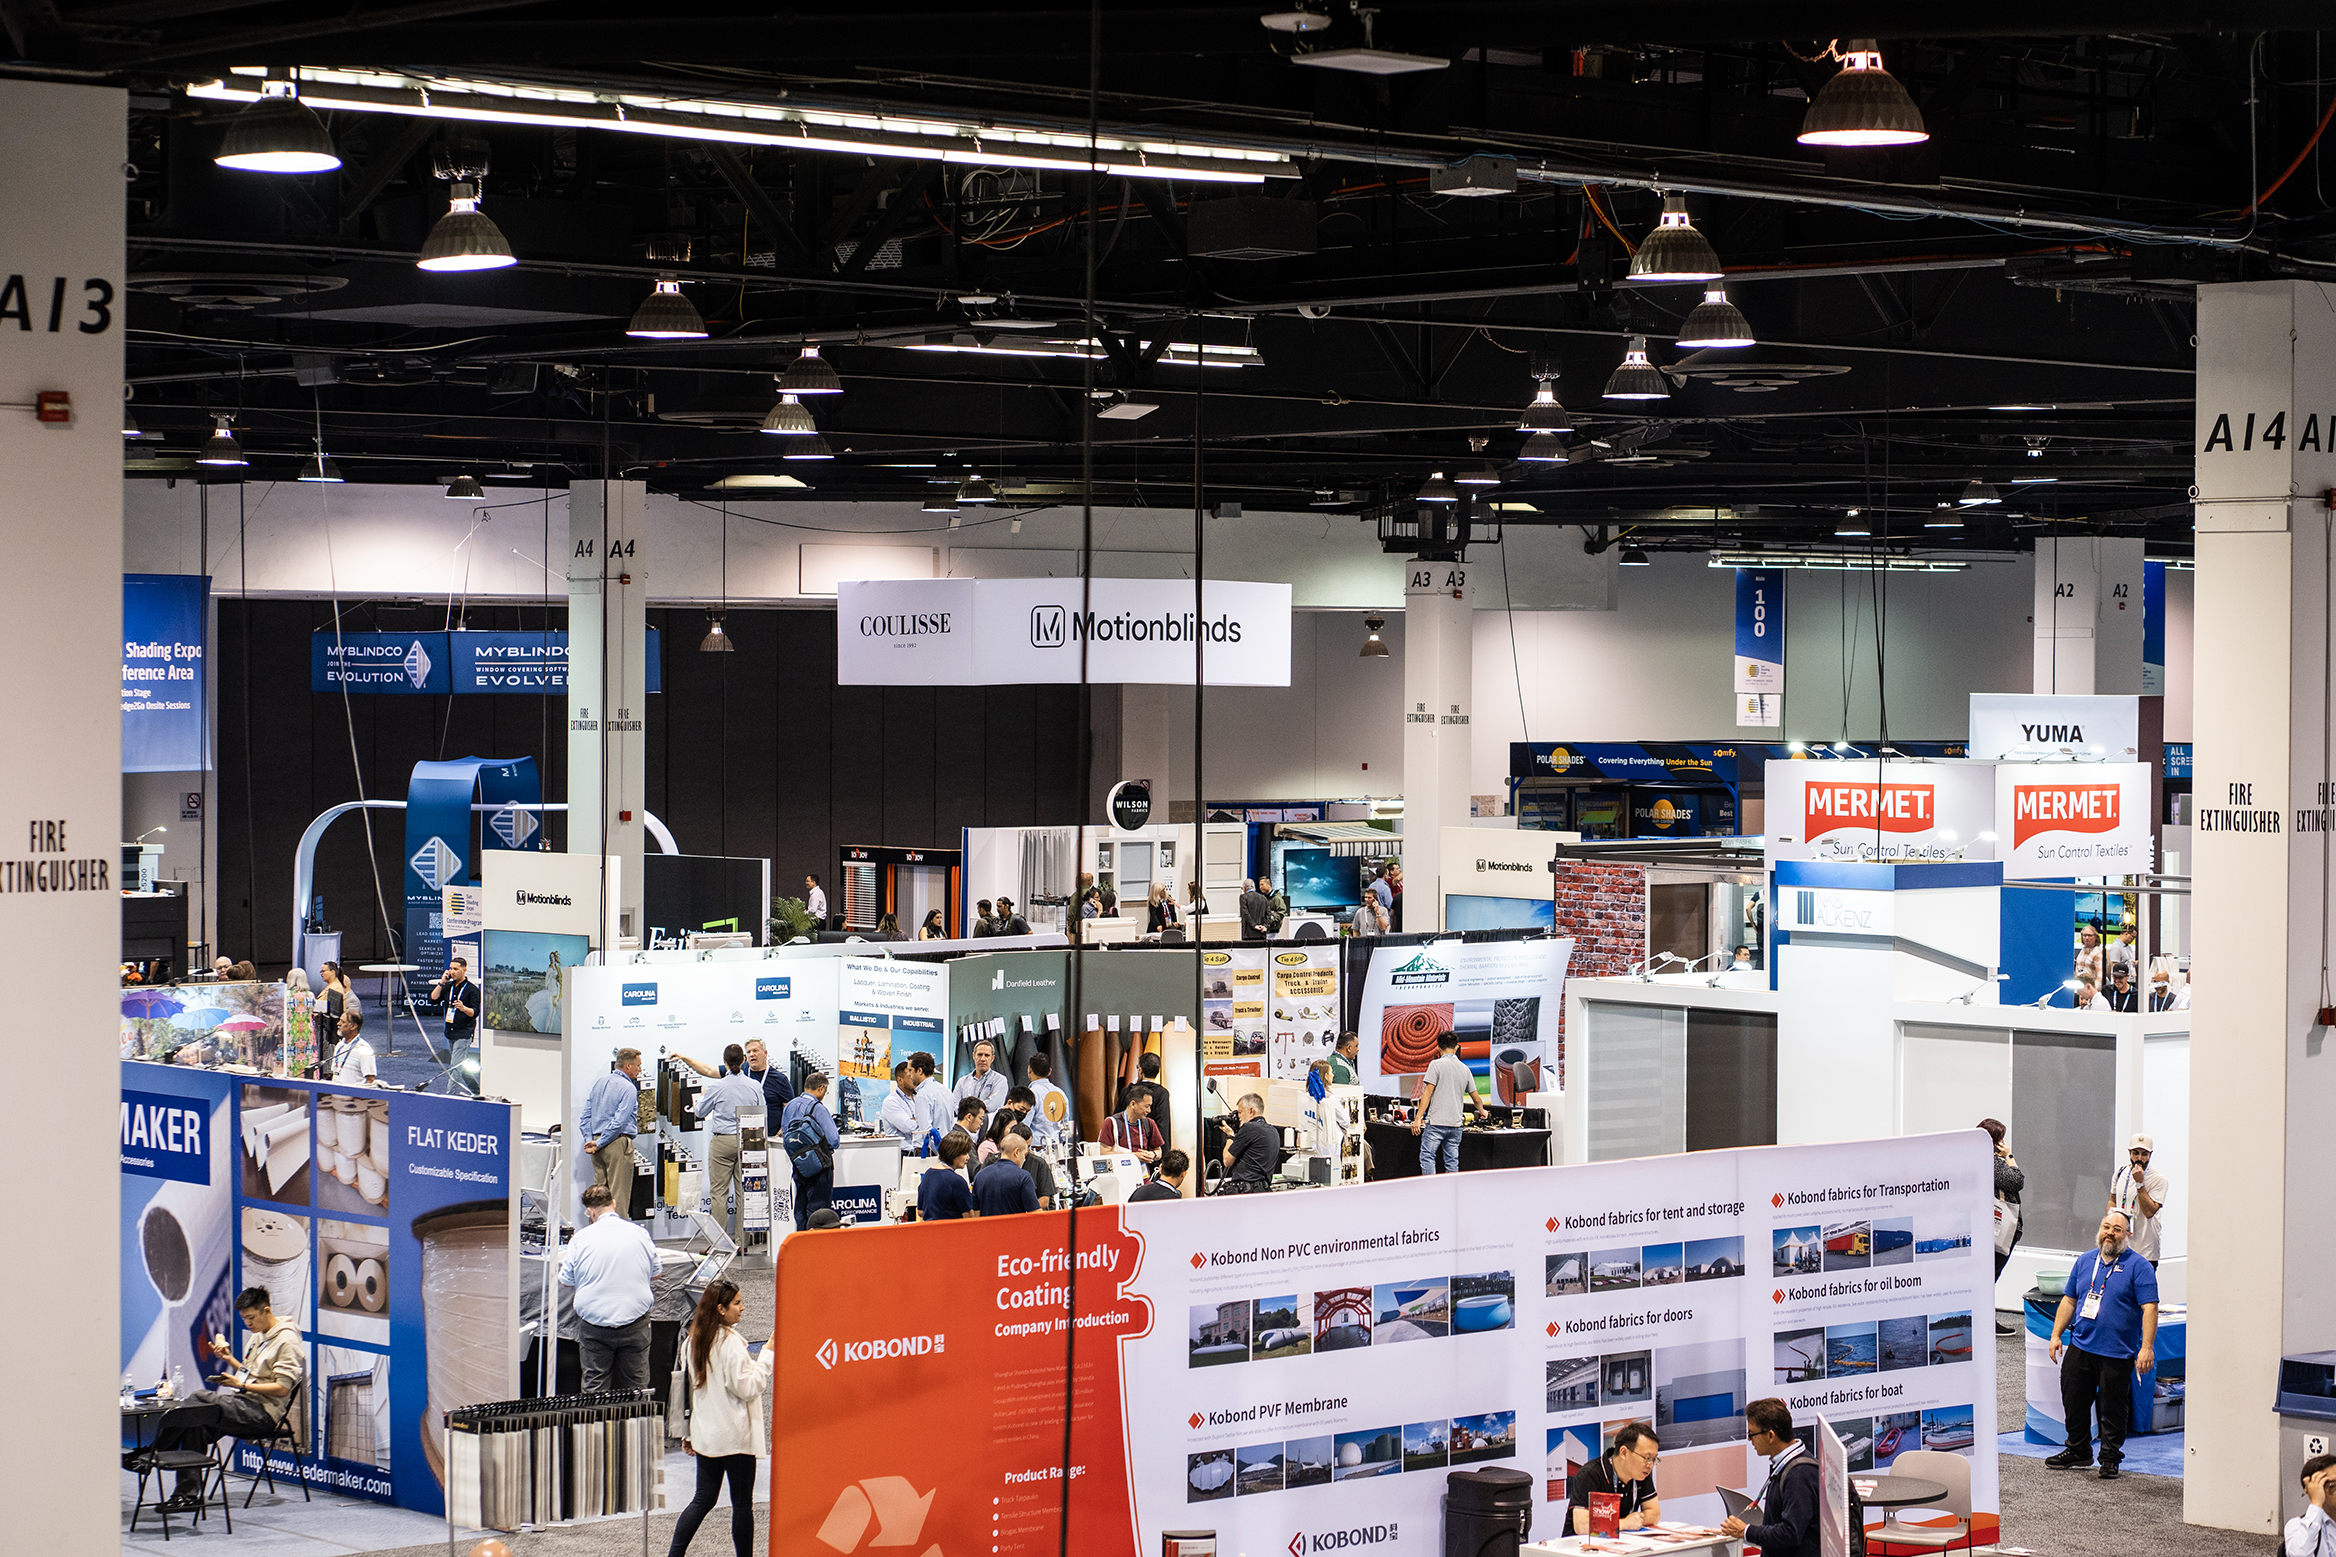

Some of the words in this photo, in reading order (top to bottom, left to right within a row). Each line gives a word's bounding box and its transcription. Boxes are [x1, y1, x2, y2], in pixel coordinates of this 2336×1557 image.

[574, 539, 594, 558] A4
[608, 539, 636, 558] A4
[1411, 571, 1431, 587] A3
[1445, 571, 1465, 587] A3
[2055, 583, 2074, 597] A2
[2113, 583, 2128, 597] A2
[1754, 589, 1766, 637] 100
[860, 612, 951, 637] COULISSE
[1072, 611, 1242, 643] Motionblinds
[125, 642, 172, 662] Shading
[173, 642, 202, 662] Expo
[326, 645, 403, 657] MYBLINDCO
[168, 664, 194, 680] Area
[326, 671, 404, 683] EVOLUTION
[475, 666, 505, 674] WINDOW
[507, 666, 542, 674] COVERING
[475, 675, 569, 685] EVOLVE
[134, 688, 151, 699] Stage
[146, 701, 165, 710] Onsite
[165, 701, 191, 710] Sessions
[1416, 703, 1426, 712] FIRE
[1450, 704, 1460, 714] FIRE
[580, 708, 589, 719] FIRE
[1406, 713, 1436, 723] EXTINGUISHER
[1440, 715, 1470, 725] EXTINGUISHER
[570, 720, 599, 731] EXTINGUISHER
[608, 720, 643, 731] XTINGUISHER
[2021, 724, 2083, 743] YUMA
[1713, 748, 1736, 758] somfy
[2170, 747, 2185, 756] ALL
[1536, 754, 1557, 764] POLAR
[1558, 754, 1584, 765] SHADES
[1598, 757, 1627, 766] Covering
[1629, 757, 1665, 767] Everything
[1666, 758, 1686, 766] Under
[1687, 758, 1699, 766] the
[1700, 758, 1713, 766] Sun
[2171, 766, 2180, 776] IN
[2229, 782, 2253, 806] FIRE
[1116, 800, 1148, 808] WILSON
[1808, 786, 1931, 820] MERMET
[2016, 789, 2118, 820] MERMET
[1634, 807, 1661, 818] POLAR
[1661, 808, 1691, 820] SHADES
[1719, 809, 1733, 817] Best
[2200, 809, 2281, 833] EXTINGUISHER
[29, 820, 67, 853] FIRE
[1833, 841, 1854, 855] Sun
[2037, 845, 2056, 859] Sun
[2058, 843, 2093, 859] Control
[2095, 843, 2129, 857] Textiles
[1488, 860, 1533, 874] Motionblinds
[527, 892, 572, 907] Motionblinds
[902, 967, 938, 977] Capabilities
[1276, 971, 1292, 979] Cargo
[757, 984, 789, 992] CAROLINA
[909, 982, 931, 992] Coating
[1006, 980, 1032, 988] Danfield
[1032, 979, 1056, 987] Leather
[623, 989, 656, 998] CAROLINA
[1290, 987, 1324, 995] ACCESSORIES
[849, 1015, 877, 1024] BALLISTIC
[903, 1019, 936, 1029] INDUSTRIAL
[408, 1126, 444, 1149] FLAT
[447, 1130, 498, 1155] KEDER
[408, 1163, 454, 1179] Customizable
[454, 1168, 498, 1184] Specification
[1787, 1188, 1826, 1205] Kobond
[1828, 1186, 1862, 1202] fabrics
[1863, 1184, 1878, 1198] for
[1879, 1178, 1950, 1201] Transportation
[831, 1197, 877, 1210] AROLINA
[841, 1208, 878, 1217] PERFORMANCE
[1565, 1212, 1606, 1230] Kobond
[1607, 1209, 1644, 1226] fabrics
[1645, 1207, 1660, 1222] for
[1662, 1206, 1684, 1220] tent
[1686, 1202, 1706, 1218] and
[1707, 1200, 1745, 1220] storage
[1211, 1247, 1258, 1266] Kobond
[1260, 1246, 1285, 1261] Non
[1288, 1242, 1311, 1258] PVC
[1313, 1231, 1400, 1256] environmental
[1401, 1228, 1440, 1249] fabrics
[998, 1244, 1120, 1277] Eco-friendly
[1788, 1283, 1827, 1301] Kobond
[1828, 1281, 1862, 1297] fabrics
[1863, 1279, 1879, 1292] for
[1879, 1276, 1892, 1290] oil
[1894, 1275, 1922, 1289] boom
[996, 1281, 1075, 1310] Coating
[995, 1320, 1052, 1338] Company
[1054, 1310, 1130, 1334] Inroduction
[1565, 1315, 1606, 1334] Kobond
[1608, 1312, 1644, 1329] fabrics
[1646, 1310, 1662, 1325] for
[1663, 1308, 1693, 1323] doors
[844, 1335, 933, 1363] KOBOND
[1790, 1391, 1828, 1410] Kobond
[1830, 1388, 1864, 1406] fabrics
[1865, 1385, 1880, 1400] for
[1881, 1383, 1904, 1397] boat
[1209, 1406, 1256, 1426] Kobond
[1259, 1403, 1282, 1419] PVF
[1285, 1397, 1348, 1416] Membrane
[1005, 1468, 1048, 1485] Product
[1049, 1465, 1086, 1480] Rage:
[1312, 1524, 1388, 1553] KOBOND
